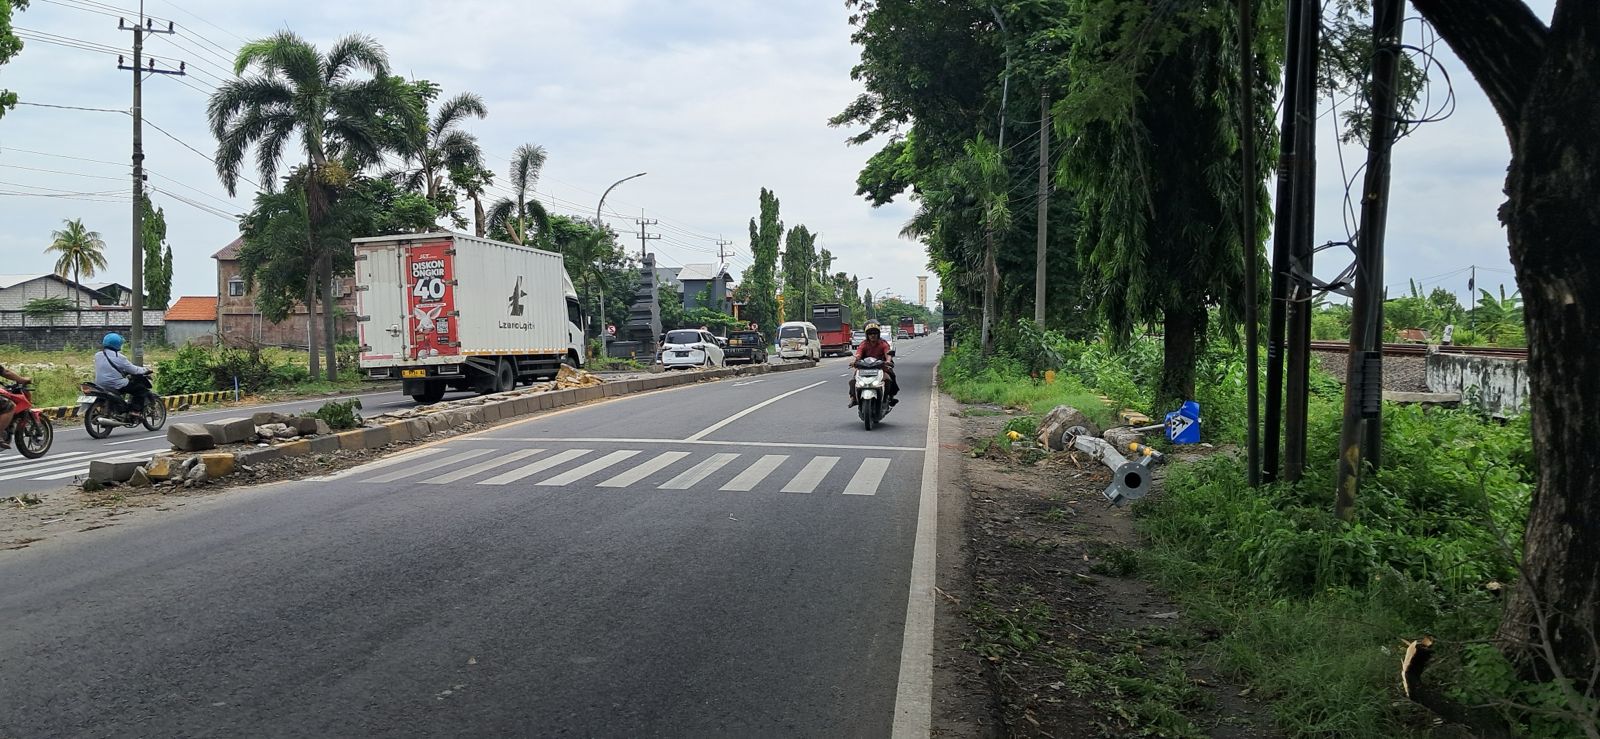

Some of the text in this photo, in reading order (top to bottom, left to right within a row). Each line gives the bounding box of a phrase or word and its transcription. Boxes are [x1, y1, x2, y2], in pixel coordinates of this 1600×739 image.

[412, 260, 444, 270] DISKON
[413, 269, 444, 277] ONGKIR
[414, 278, 446, 298] 40
